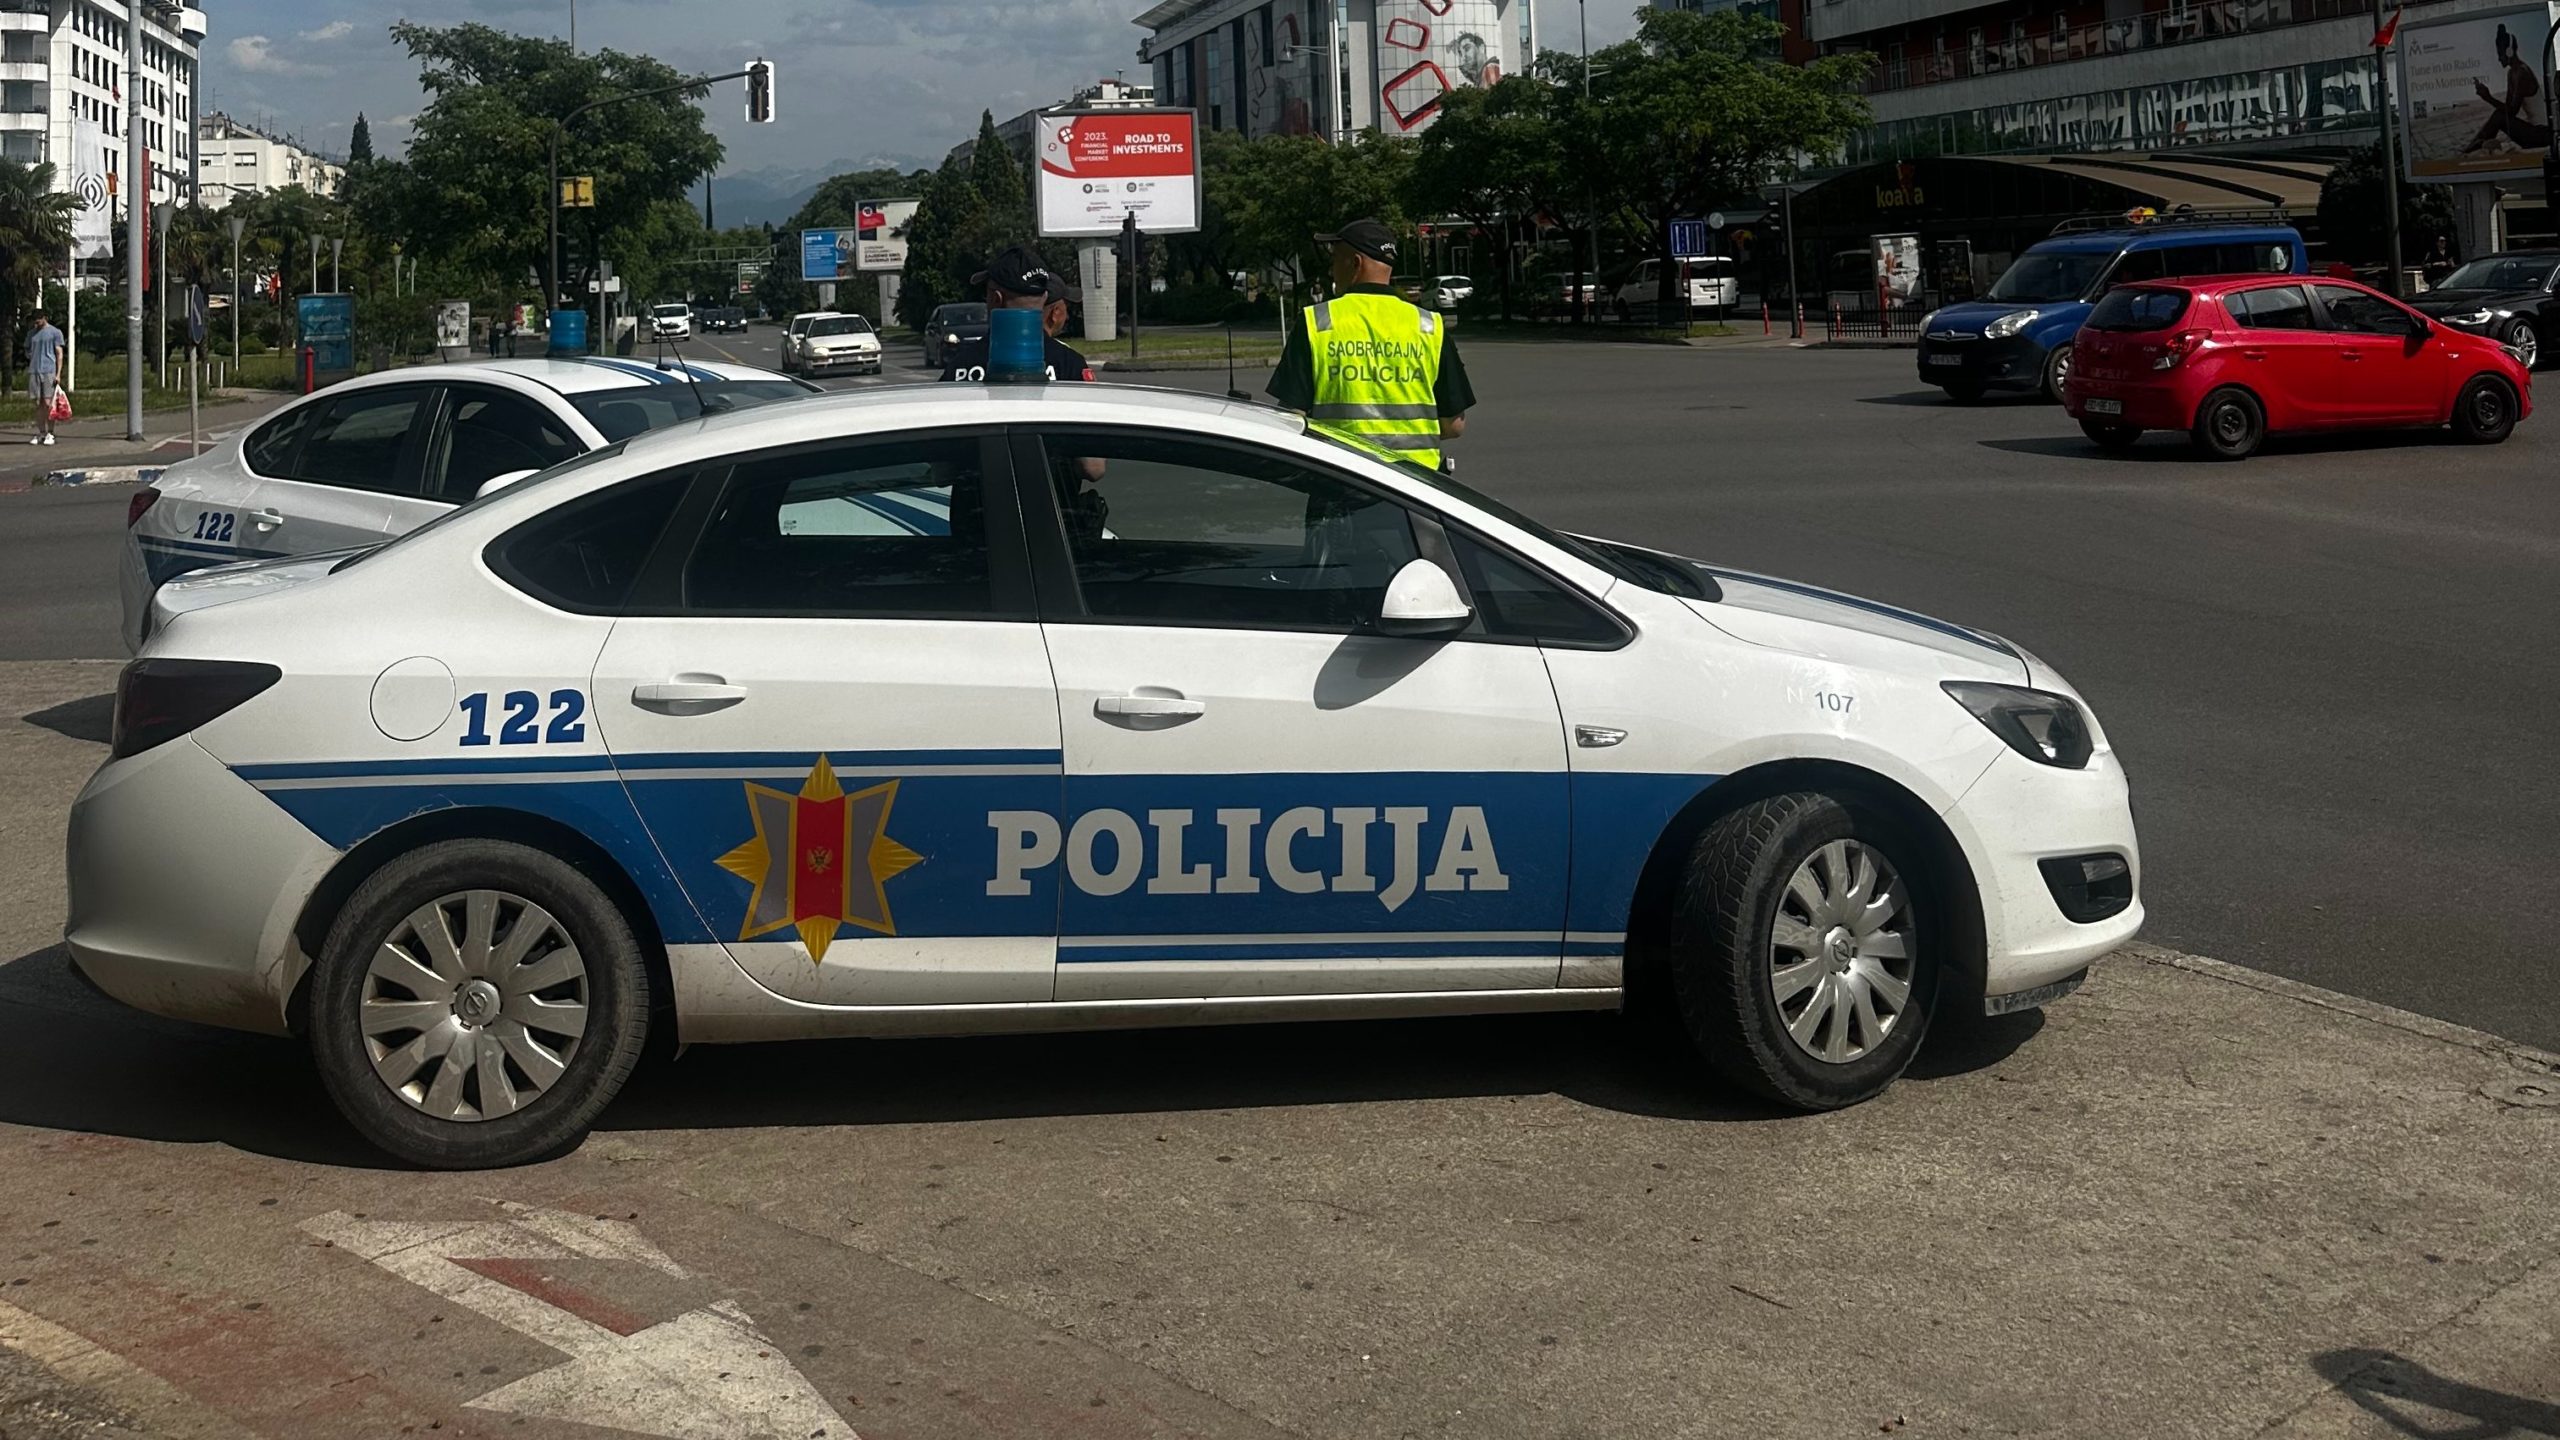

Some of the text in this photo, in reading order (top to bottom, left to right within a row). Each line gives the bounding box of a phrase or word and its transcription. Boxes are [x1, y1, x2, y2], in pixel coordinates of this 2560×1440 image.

[2454, 56, 2481, 70] Radio
[1112, 143, 1184, 155] INVESTMENTS
[1125, 133, 1171, 144] ROAD TO
[1327, 364, 1425, 383] POLICIJA
[193, 511, 235, 542] 122
[1814, 691, 1854, 714] 107
[459, 689, 585, 746] 122
[985, 805, 1511, 914] POLICIJA
